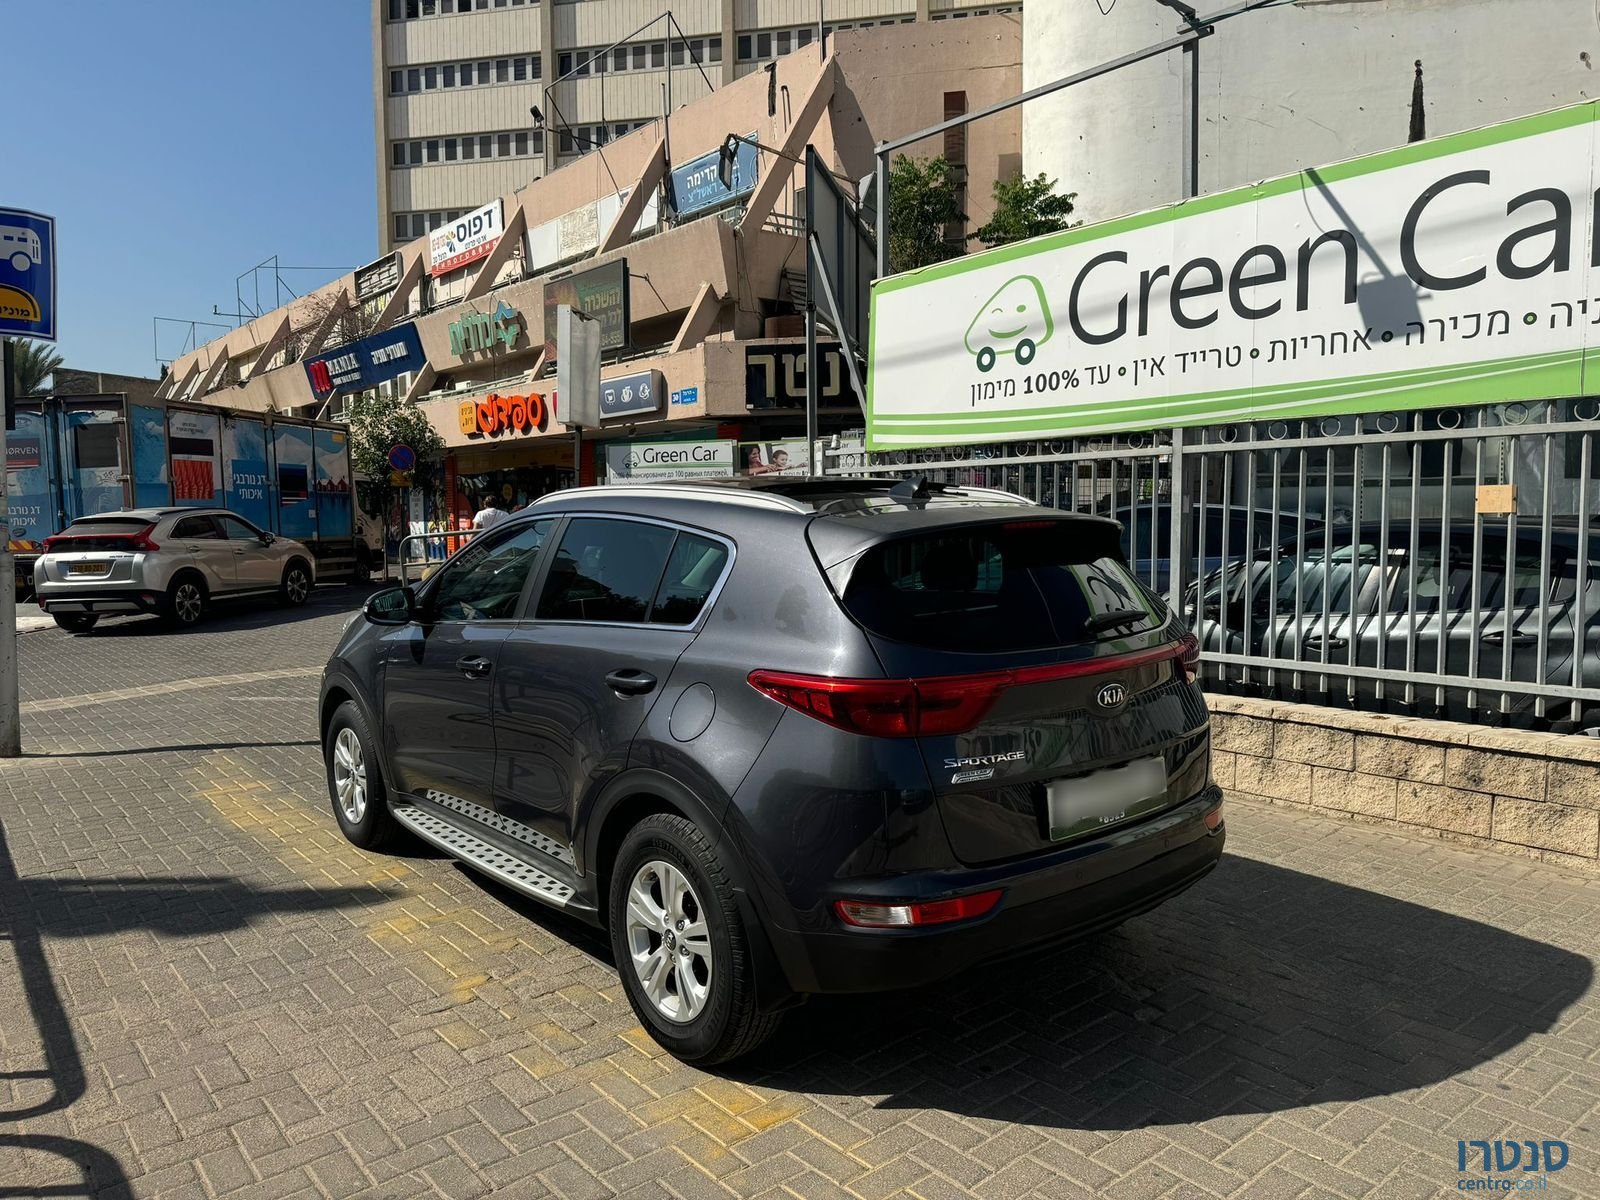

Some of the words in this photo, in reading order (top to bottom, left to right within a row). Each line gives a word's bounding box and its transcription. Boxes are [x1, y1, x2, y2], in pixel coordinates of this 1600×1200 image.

[686, 165, 717, 188] קדימה
[456, 208, 493, 243] דפוס
[1068, 229, 1359, 346] Green
[1405, 309, 1510, 346] מכירה
[1267, 328, 1373, 363] אחריות
[325, 352, 359, 376] MANIA
[1133, 355, 1166, 386] אין
[1175, 345, 1242, 373] טרייד
[1023, 369, 1080, 395] 100%
[1084, 366, 1111, 386] עד
[970, 377, 1016, 407] מימון
[643, 448, 688, 464] Green
[692, 446, 718, 461] Car
[10, 516, 37, 526] איכותי
[30, 505, 41, 515] דג
[1103, 688, 1123, 705] KIA
[944, 751, 1026, 769] SPORTAGE
